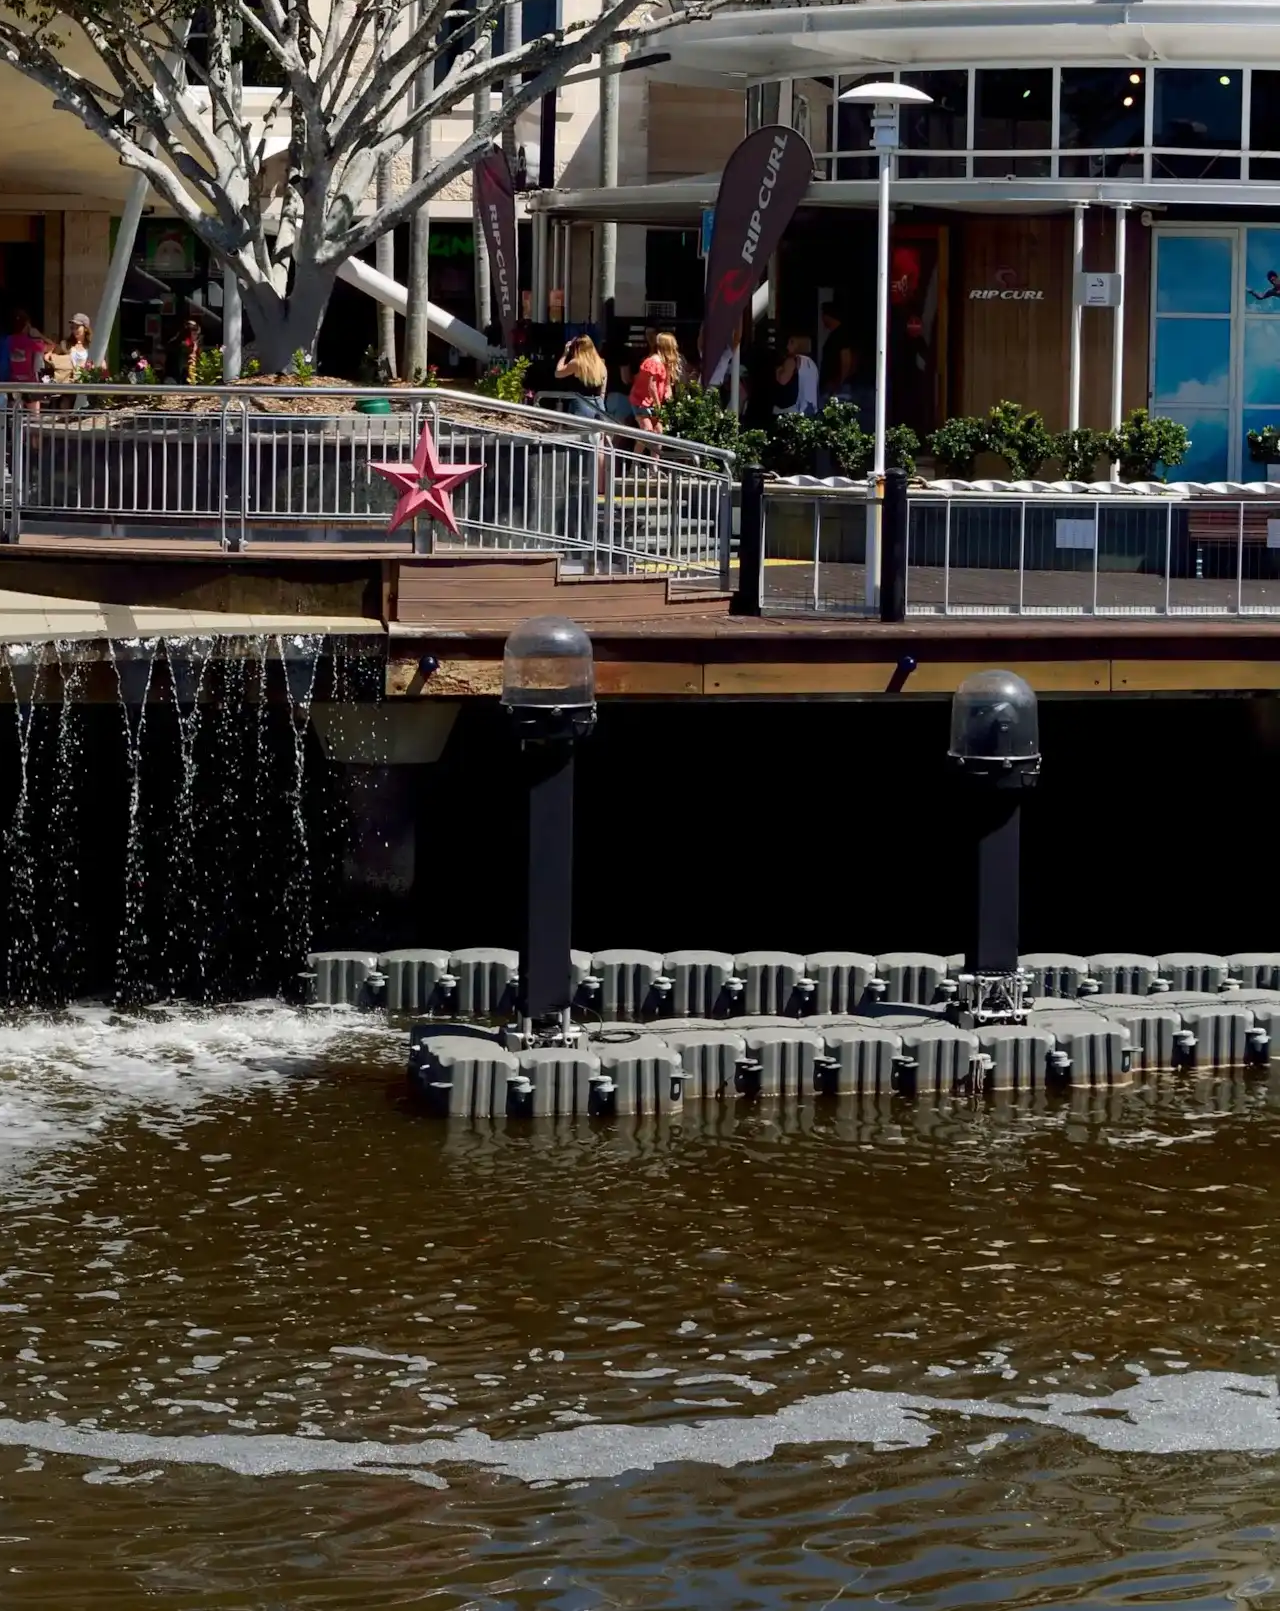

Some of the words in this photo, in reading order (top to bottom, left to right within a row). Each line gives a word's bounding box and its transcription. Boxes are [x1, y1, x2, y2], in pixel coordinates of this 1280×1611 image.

[741, 210, 763, 265] RIP
[758, 134, 789, 209] CURL
[489, 204, 502, 246] RIP
[496, 247, 512, 317] CURL
[969, 290, 999, 300] RIP
[1000, 290, 1045, 300] CURL
